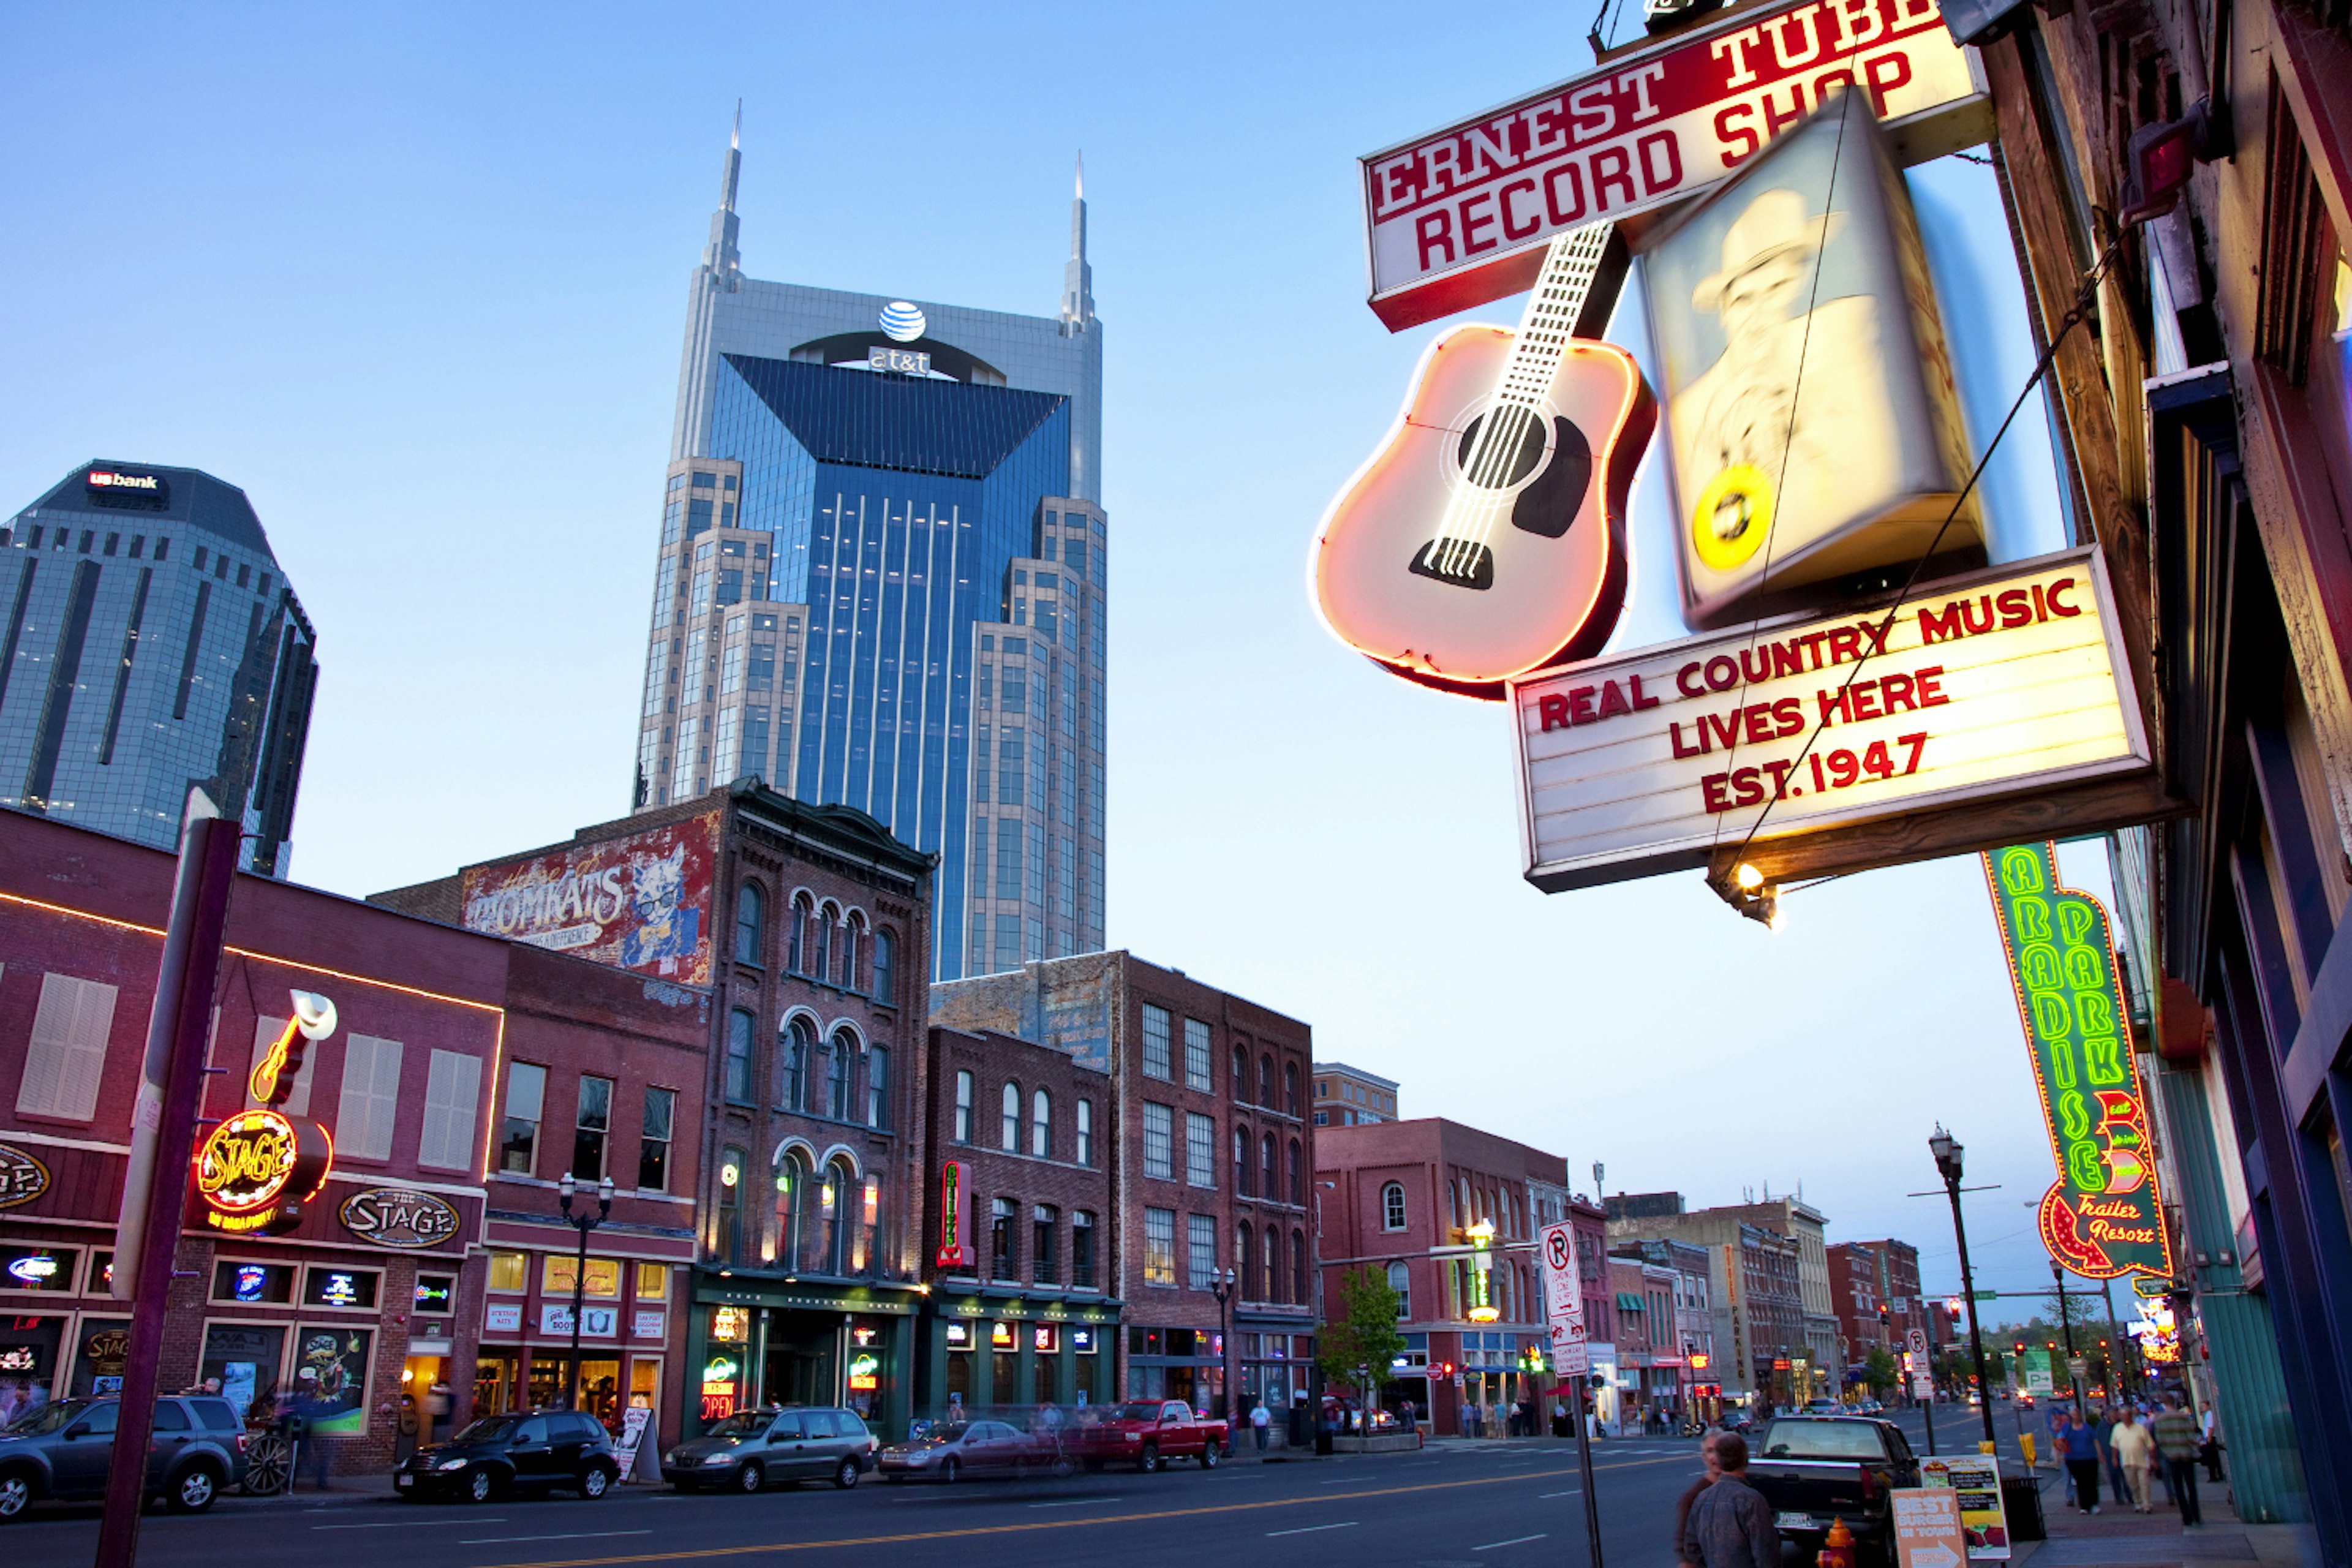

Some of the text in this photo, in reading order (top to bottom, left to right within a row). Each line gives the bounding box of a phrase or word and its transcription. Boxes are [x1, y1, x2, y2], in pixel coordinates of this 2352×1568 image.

[1374, 61, 1665, 217] ERNEST
[1414, 129, 1683, 271] RECORD
[870, 348, 928, 374] at&t
[1540, 578, 2082, 733] REAL COUNTRY MUSIC
[1668, 665, 1950, 761] LIVES HERE
[2057, 901, 2124, 1085] PARK
[2002, 845, 2105, 1191] ARADISE
[200, 1128, 288, 1193] STAGE
[347, 1194, 453, 1234] STAGE
[392, 1193, 415, 1204] THE
[2078, 1194, 2142, 1219] Trailer
[2089, 1218, 2155, 1243] Resort
[88, 1333, 130, 1358] STAG
[1732, 1306, 1745, 1379] PARKING
[1896, 1496, 1953, 1515] BEST
[1898, 1513, 1955, 1526] BURGER
[1900, 1526, 1956, 1538] IN TOWN
